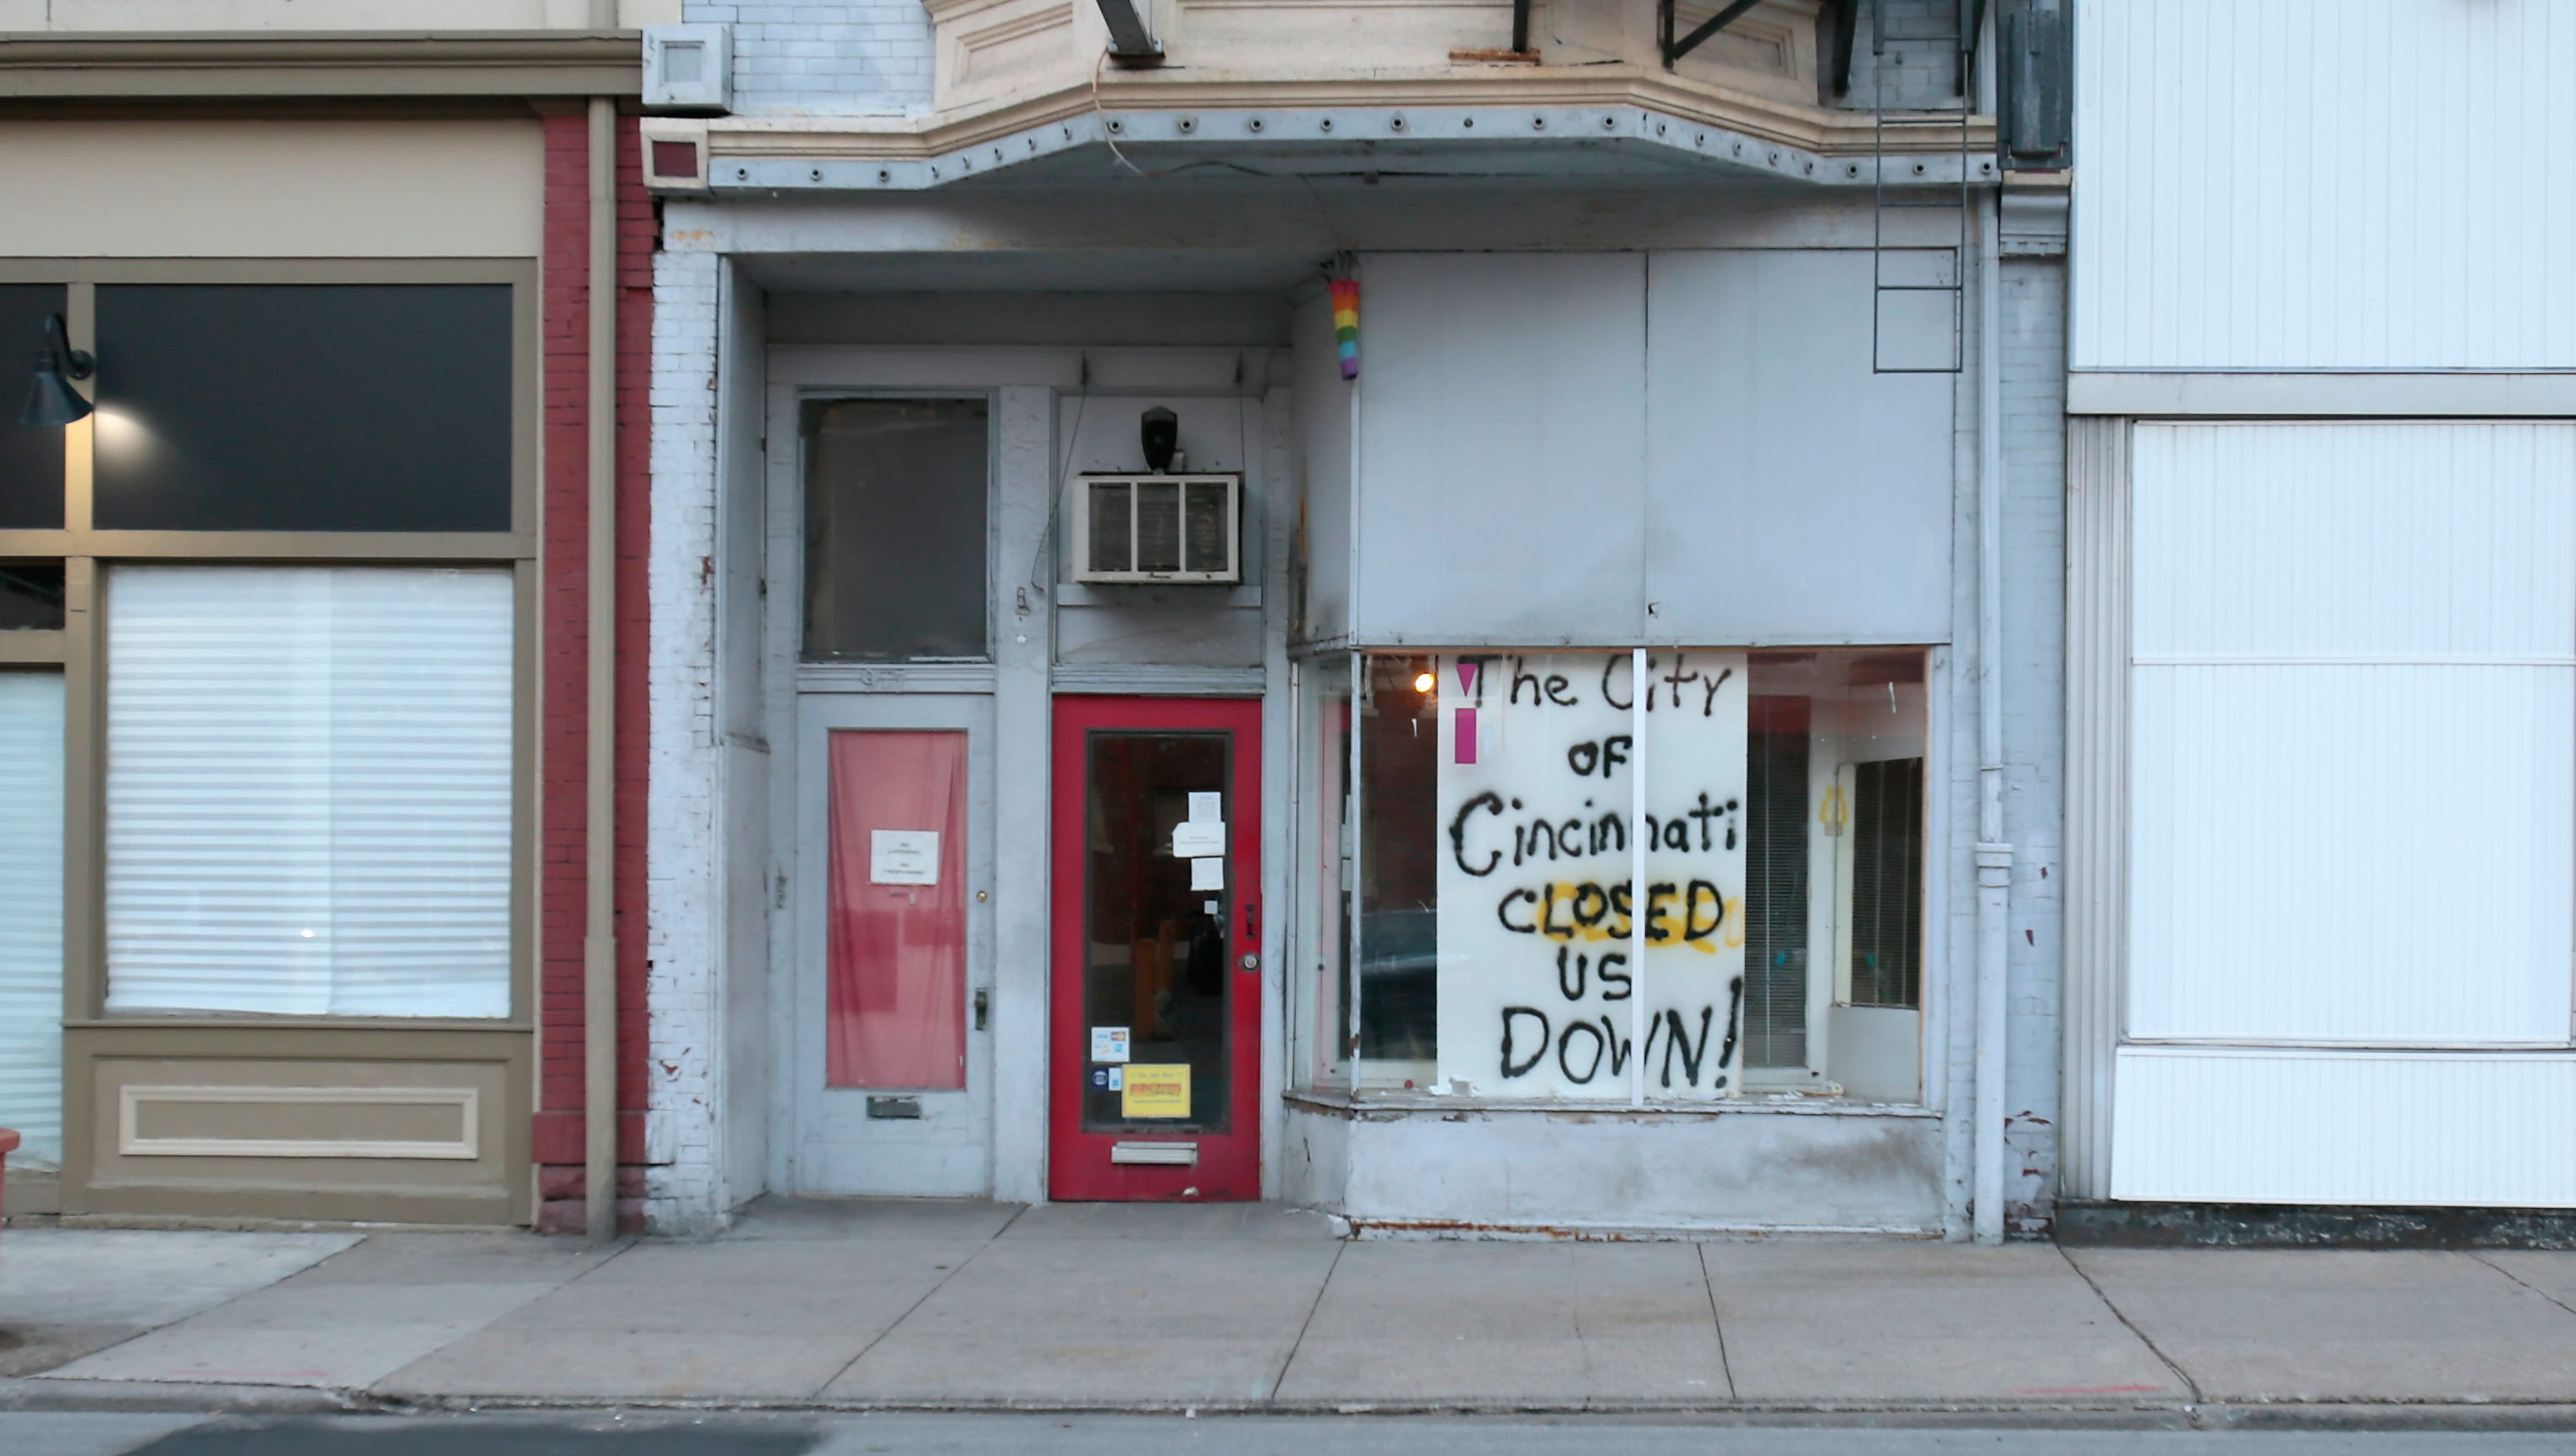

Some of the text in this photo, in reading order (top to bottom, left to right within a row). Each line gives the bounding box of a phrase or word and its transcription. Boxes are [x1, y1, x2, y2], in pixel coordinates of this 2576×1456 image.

[1457, 654, 1731, 717] The City
[1498, 879, 1724, 942] CLOSED
[1556, 945, 1632, 1001] US
[1500, 977, 1742, 1089] DOWN!
